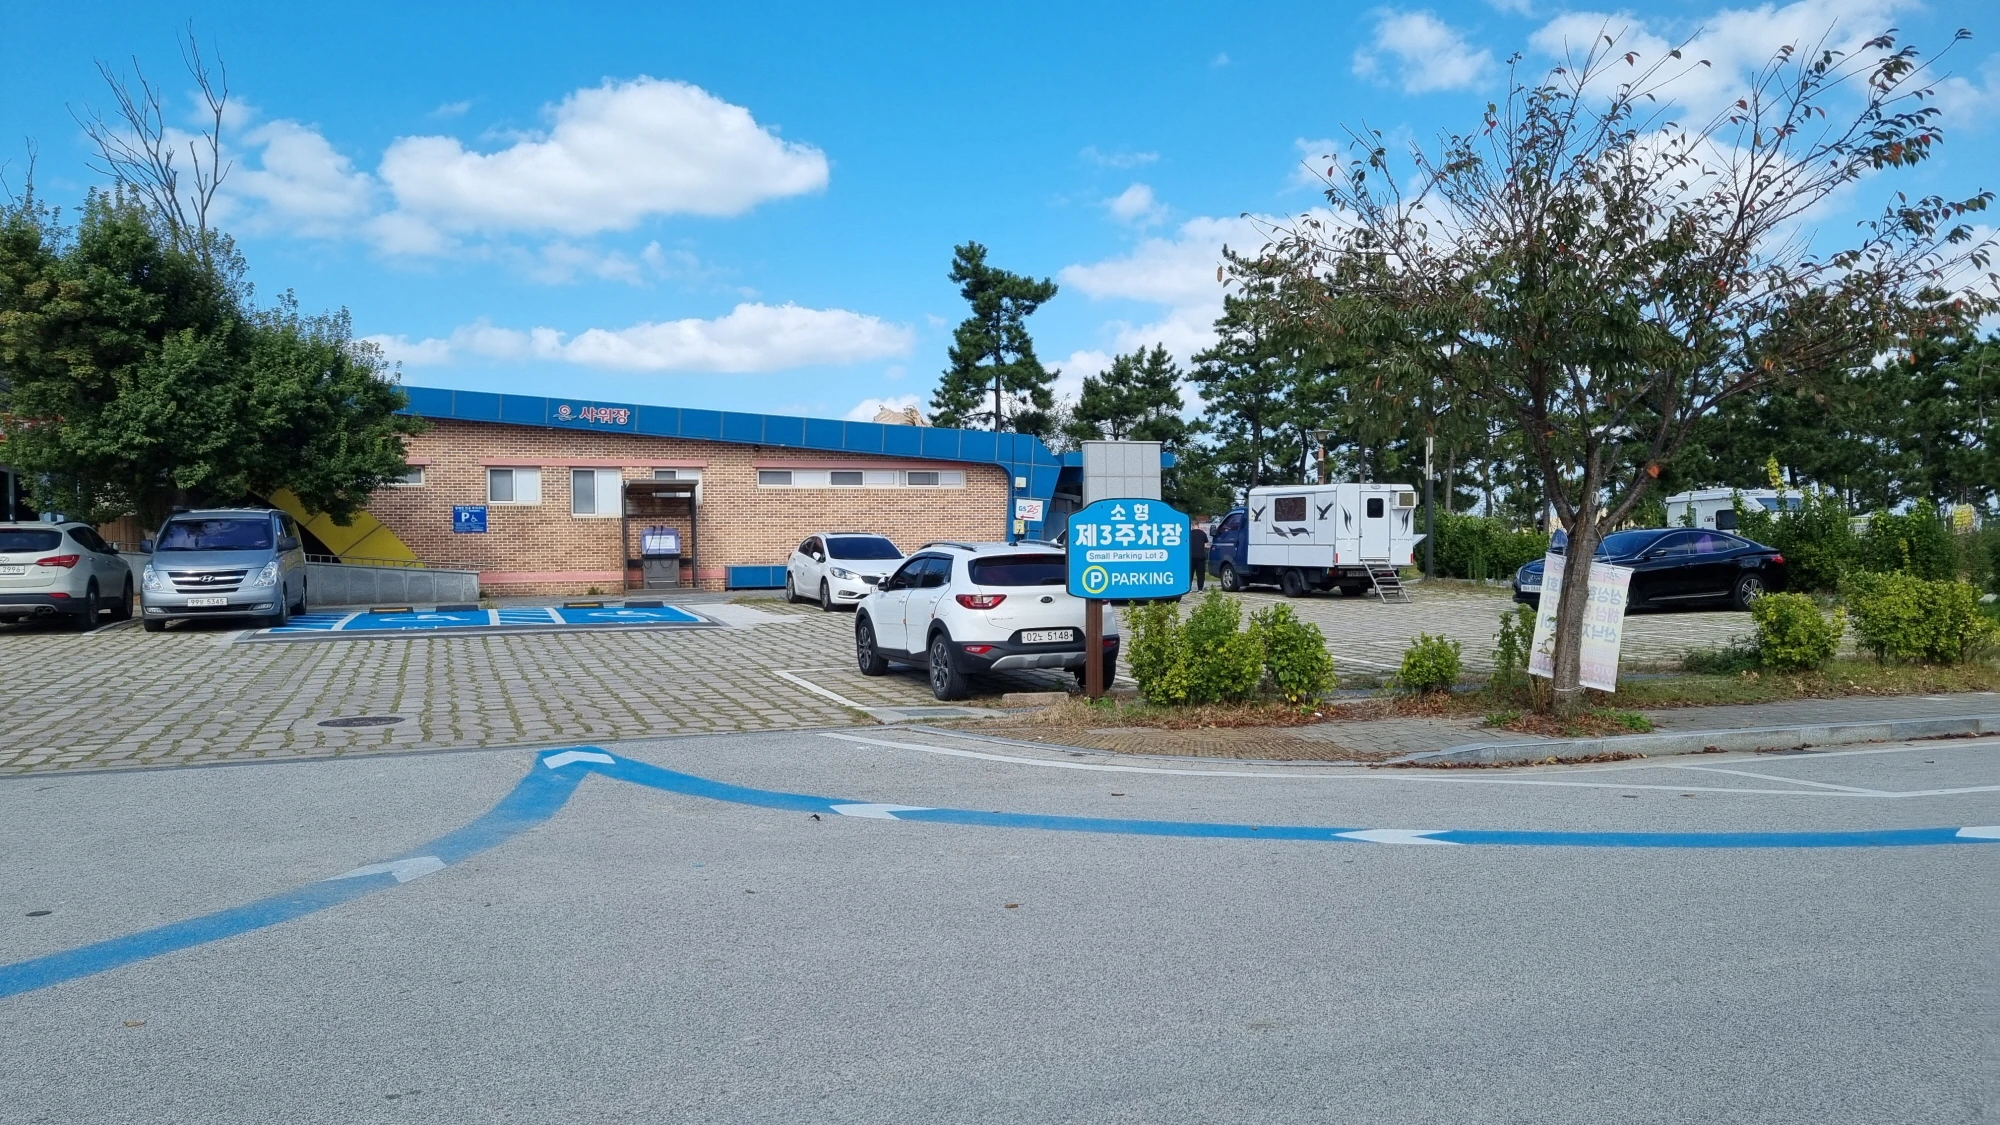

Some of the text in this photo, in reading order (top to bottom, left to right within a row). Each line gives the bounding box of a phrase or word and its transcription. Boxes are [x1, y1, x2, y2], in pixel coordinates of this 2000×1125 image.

[579, 407, 630, 425] 샤워장
[461, 512, 470, 523] P
[1075, 523, 1182, 547] 제3주차장
[1089, 551, 1164, 560] Small Parking Lot 2
[1090, 571, 1174, 588] P PARKING
[1026, 631, 1069, 641] 02노 5148
